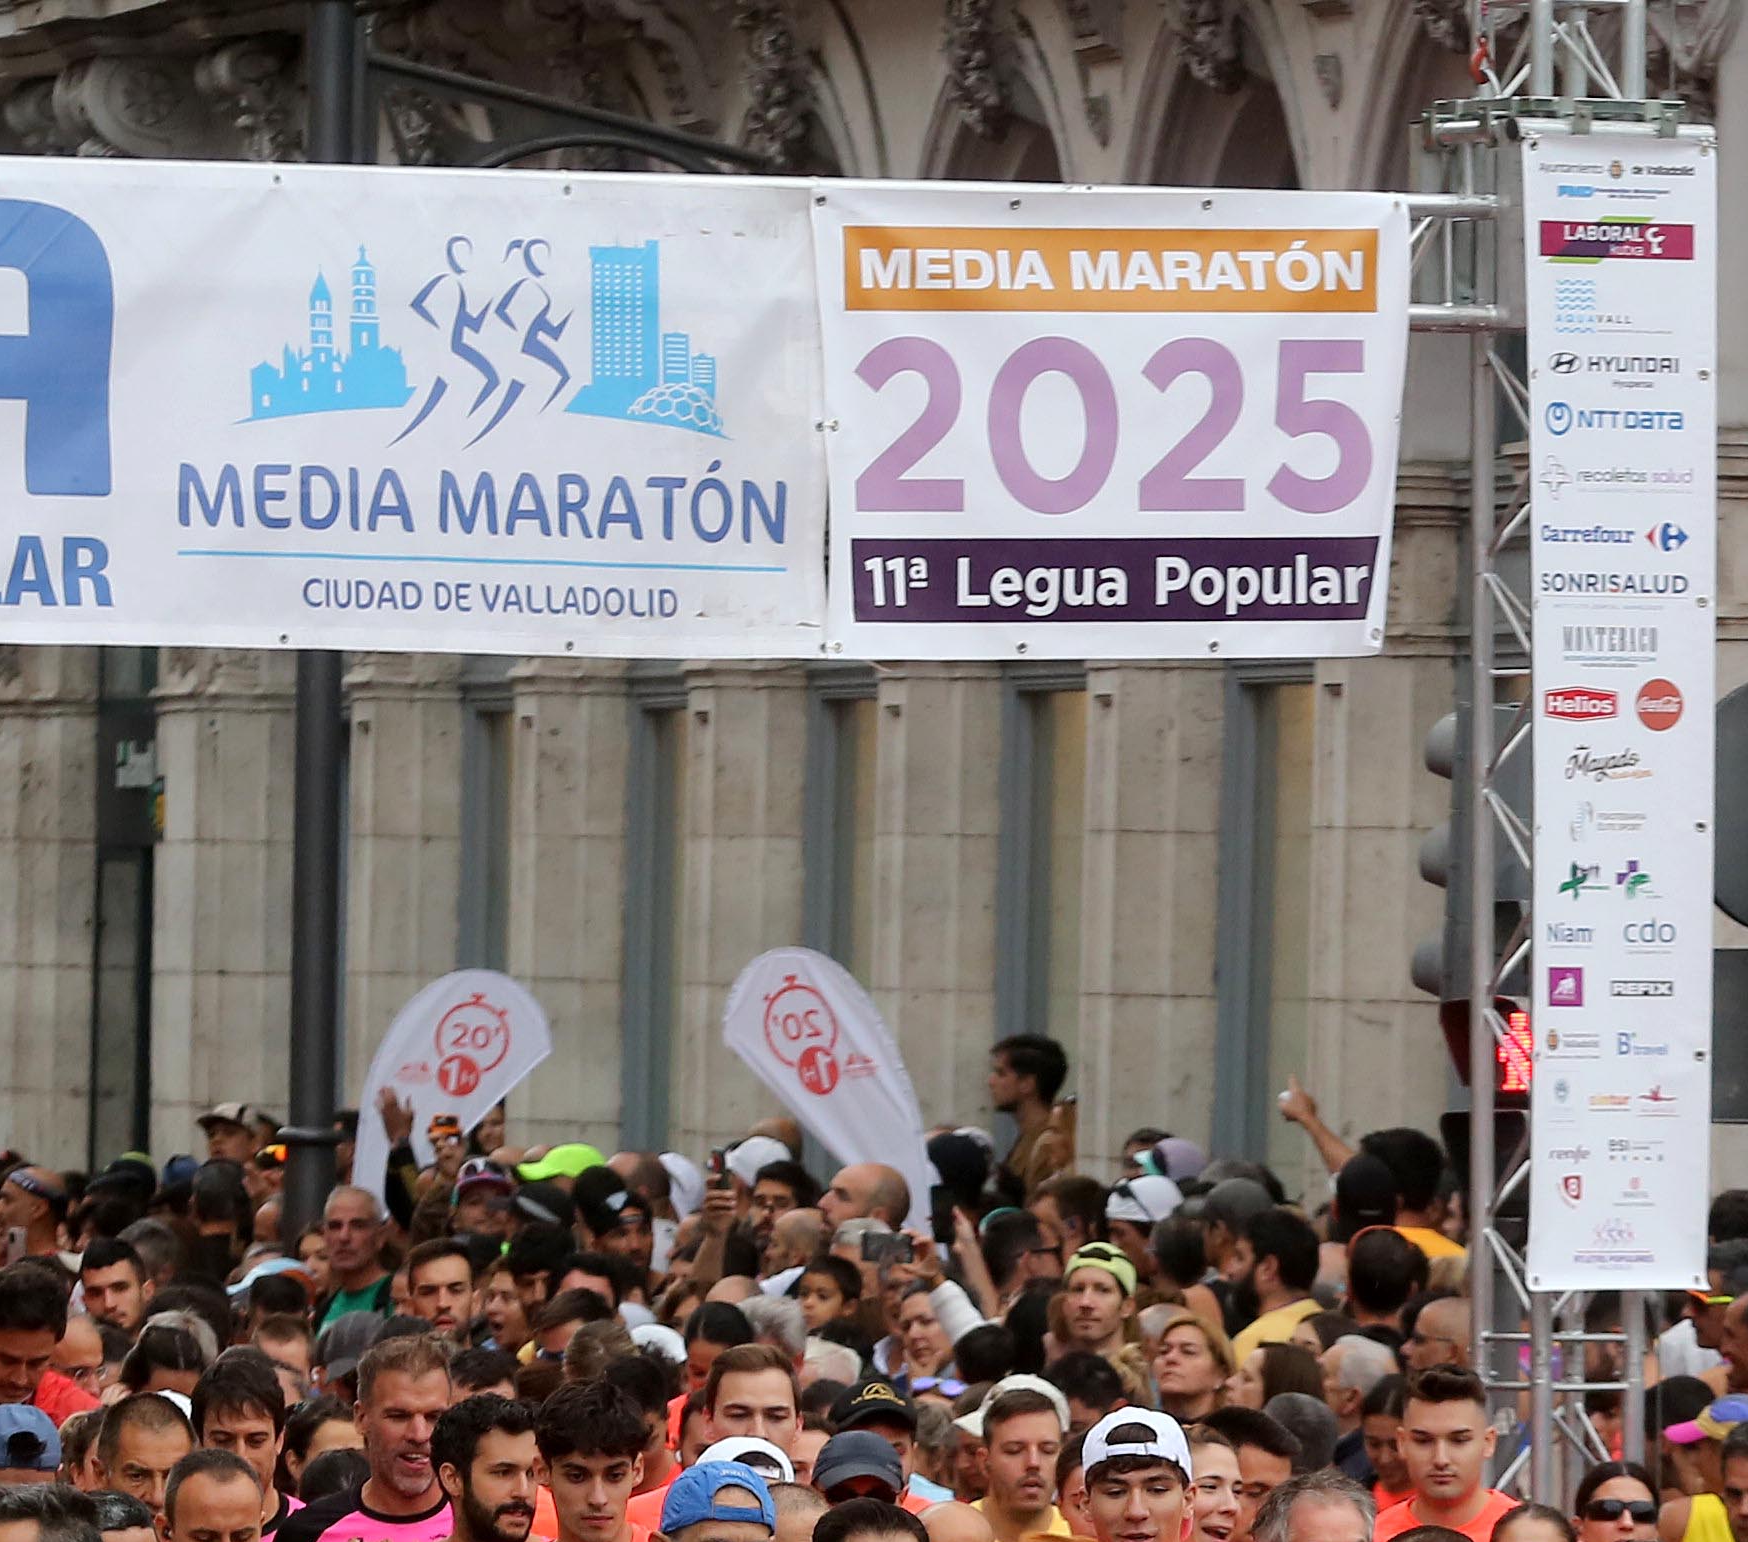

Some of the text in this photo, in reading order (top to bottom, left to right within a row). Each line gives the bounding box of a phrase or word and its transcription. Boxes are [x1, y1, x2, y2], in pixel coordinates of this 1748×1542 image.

[1563, 224, 1645, 243] LABORAL
[858, 240, 1364, 292] MEDIA MARATÓN
[1556, 314, 1633, 325] AQUAVALL
[1587, 357, 1680, 374] HYUNDAI
[854, 335, 1373, 515] 2025
[1577, 410, 1621, 430] NTT
[177, 459, 787, 544] MEDIA MARATÓN
[1541, 525, 1637, 544] Carrefour
[864, 553, 1369, 617] 11ª Legua Popular
[1541, 573, 1690, 595] SONRISALUD
[302, 577, 679, 618] CIUDAD DE VALLADOLID
[1546, 694, 1615, 714] Helios
[1623, 918, 1677, 944] cdo
[451, 1022, 502, 1050] 20'
